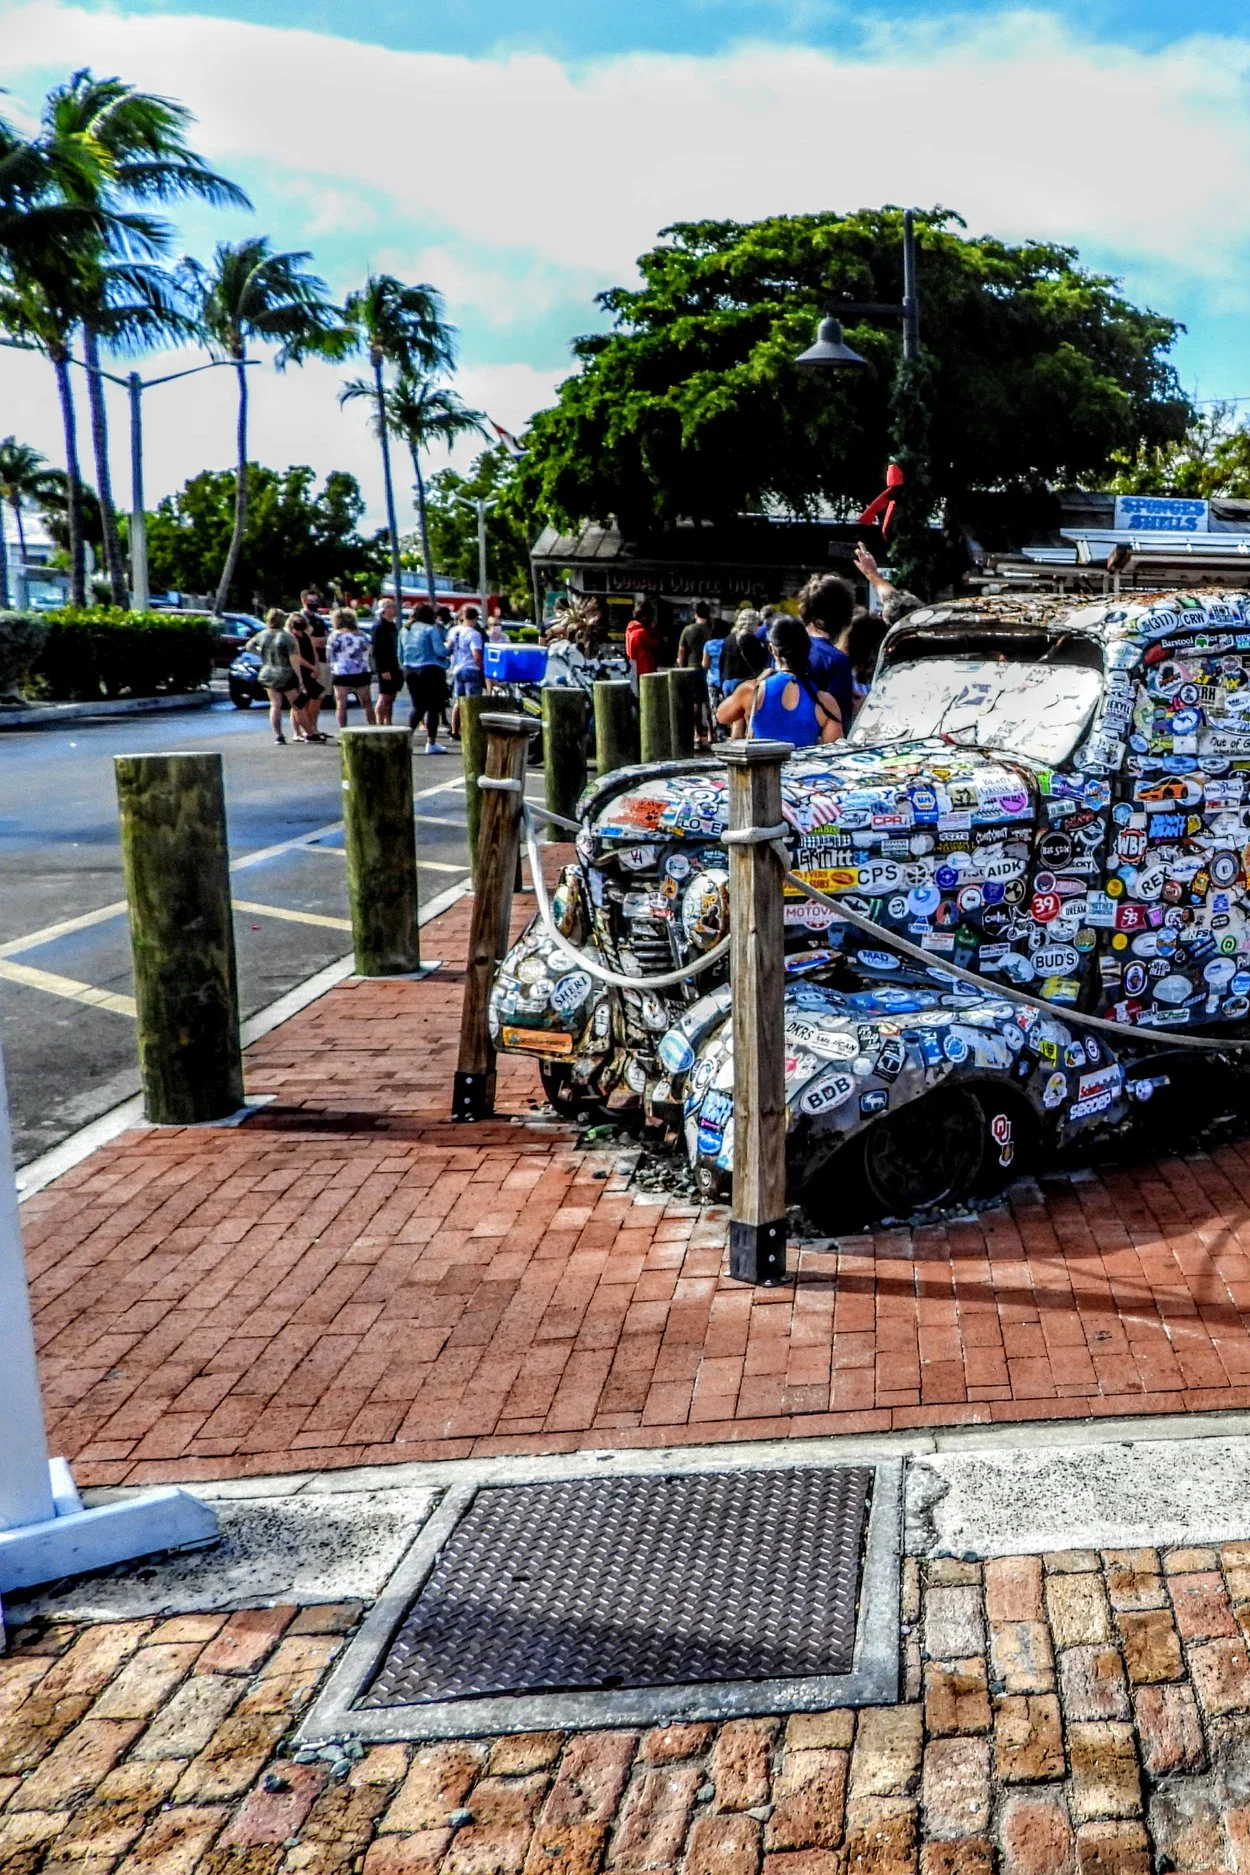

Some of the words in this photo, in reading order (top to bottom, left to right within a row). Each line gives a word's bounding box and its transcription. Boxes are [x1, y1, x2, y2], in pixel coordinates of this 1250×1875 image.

[1128, 515, 1198, 531] SHELLS
[1149, 612, 1174, 630] (317)
[1183, 612, 1205, 625] CRW
[1161, 636, 1194, 648] Barstool
[1106, 700, 1130, 714] JEKYLL
[1210, 736, 1227, 749] Out
[1230, 738, 1240, 749] of
[872, 815, 902, 825] CPR
[858, 865, 898, 885] CPS
[988, 861, 1021, 878] AIDK
[1142, 866, 1172, 895] REX
[1033, 896, 1055, 914] 39
[1065, 904, 1087, 916] DREAM
[862, 950, 889, 961] MAD
[1035, 952, 1075, 969] BUD'S
[786, 1021, 815, 1041] DKRS
[807, 1077, 851, 1110] BDB
